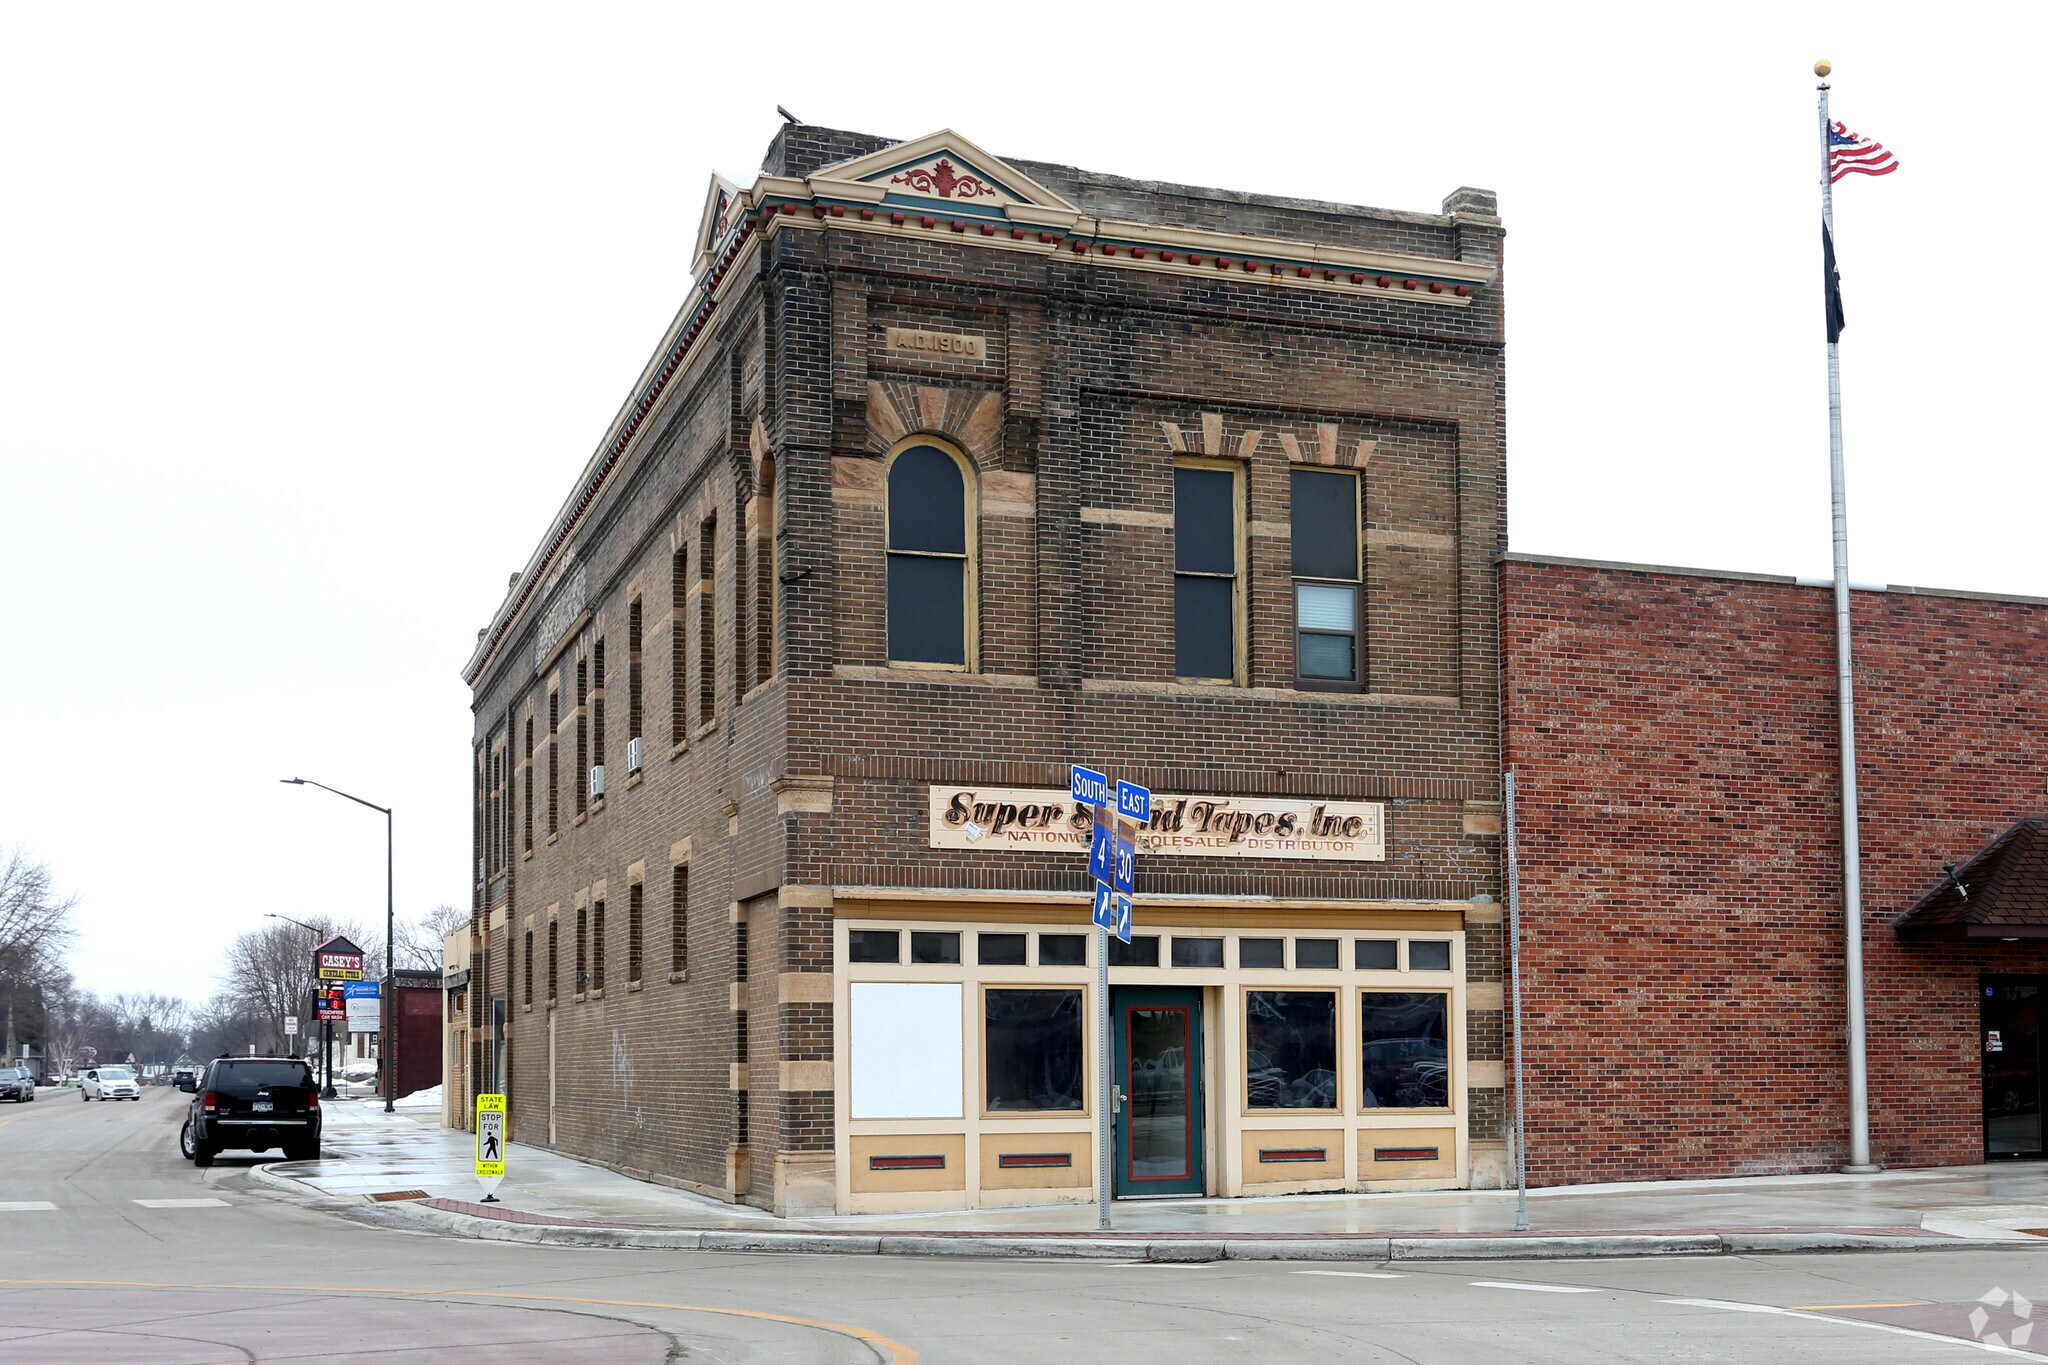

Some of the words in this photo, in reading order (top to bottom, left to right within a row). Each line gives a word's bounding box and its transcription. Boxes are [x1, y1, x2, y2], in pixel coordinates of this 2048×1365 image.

[1074, 773, 1105, 803] SOUTH
[1121, 787, 1146, 815] EAST
[946, 791, 1064, 836] Super
[1097, 838, 1106, 869] 4
[1249, 838, 1355, 851] DISTRIBUTOR
[1118, 849, 1132, 884] 30
[322, 955, 360, 968] CASEY'S
[481, 1113, 502, 1121] STOP
[483, 1123, 499, 1131] FOR
